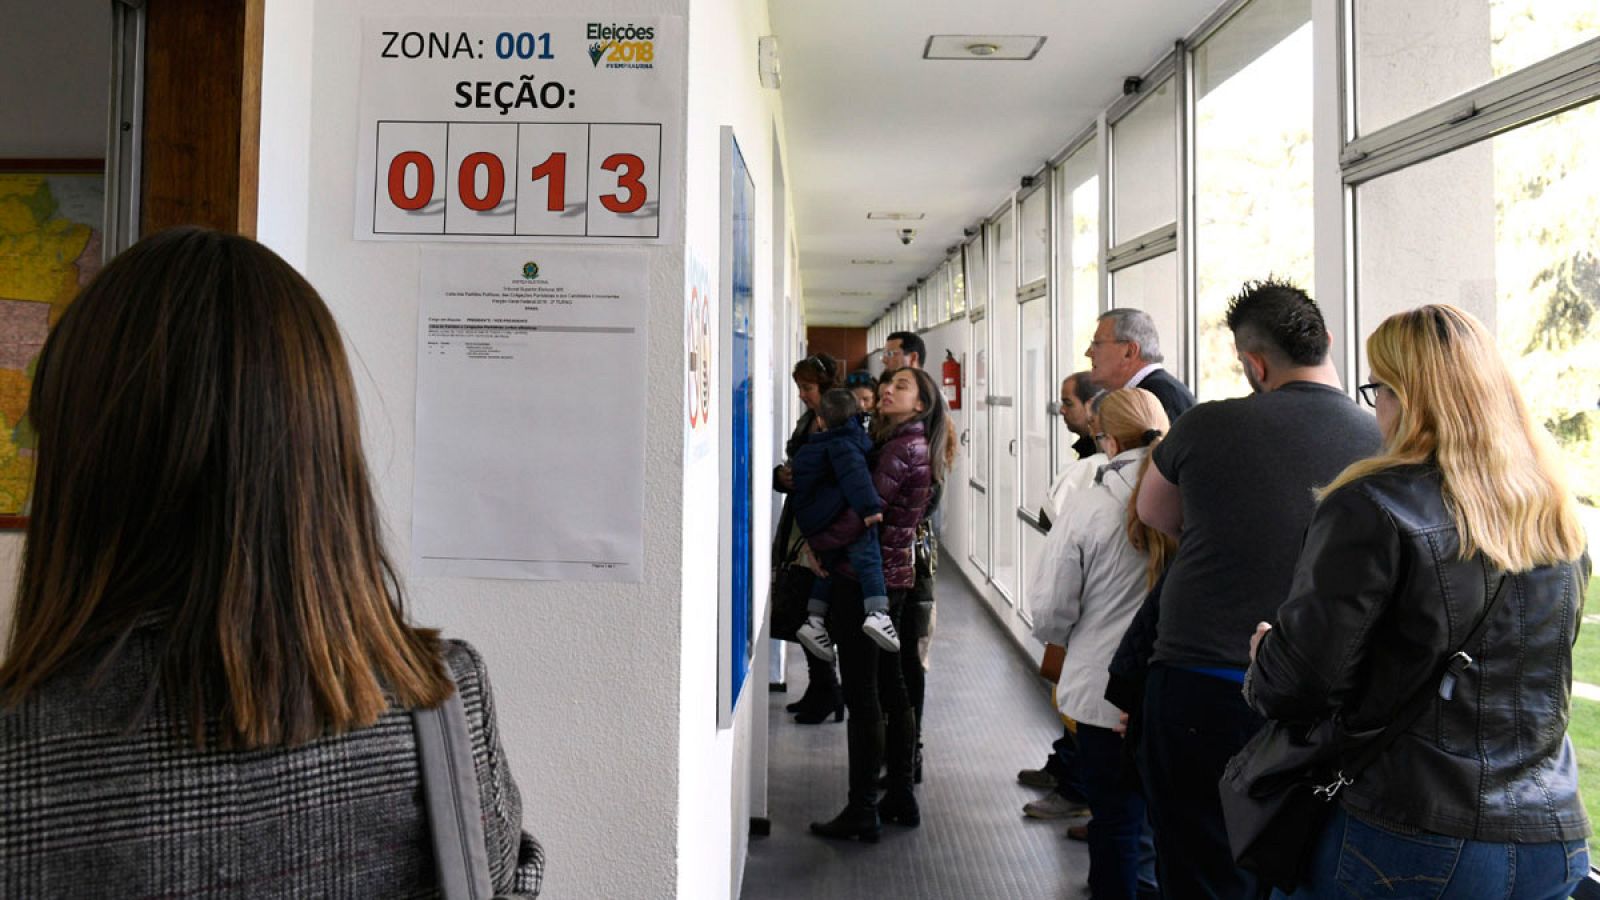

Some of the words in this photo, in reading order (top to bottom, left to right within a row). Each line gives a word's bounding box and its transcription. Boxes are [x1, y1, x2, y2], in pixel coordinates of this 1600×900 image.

[586, 22, 655, 43] Eleições
[381, 31, 484, 59] ZONA:
[495, 31, 555, 60] 001
[606, 41, 655, 63] 2018
[454, 74, 577, 115] SEÇÃO:
